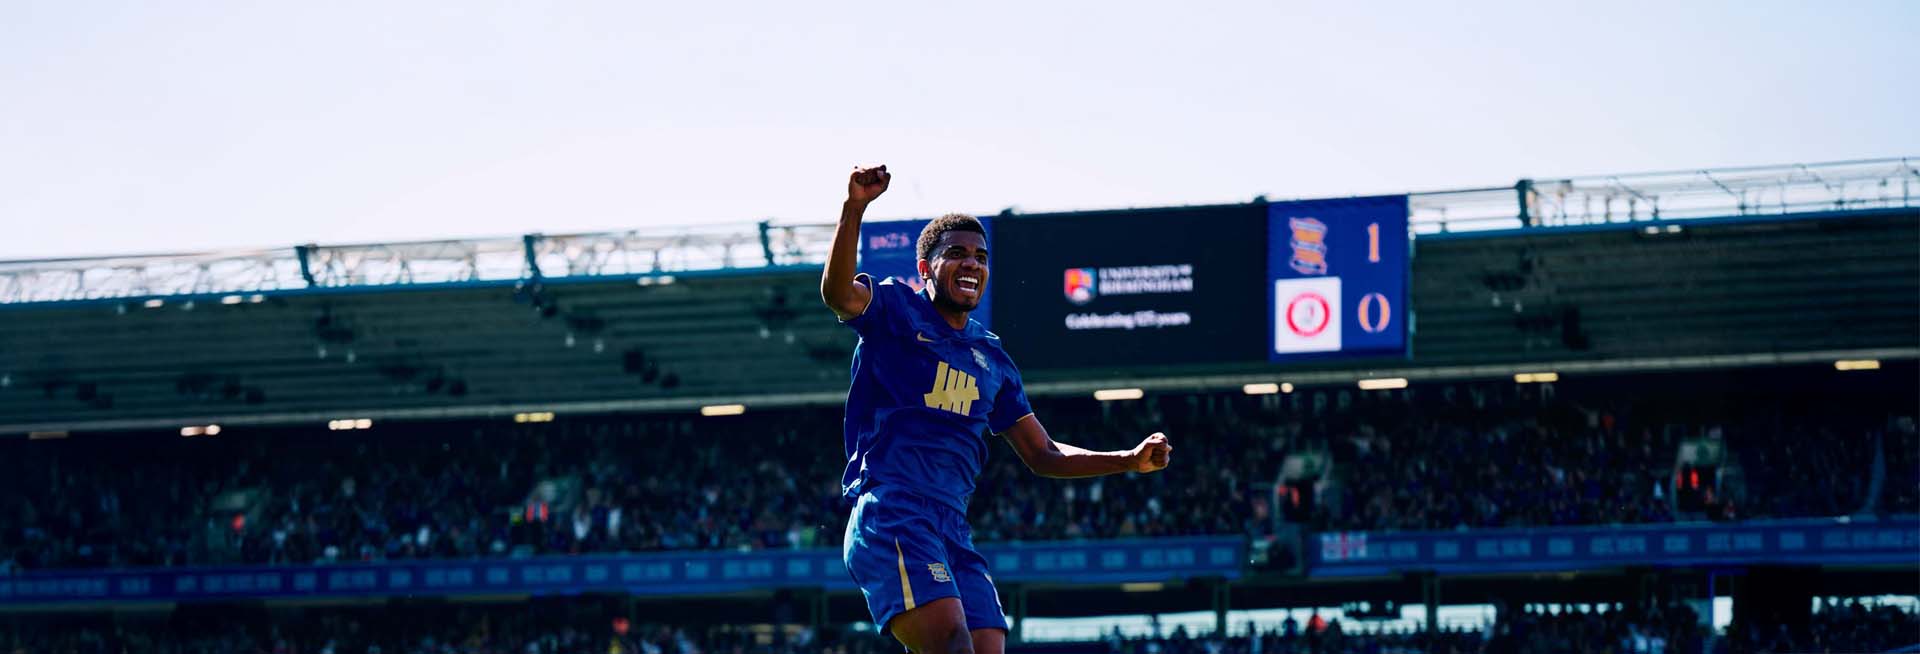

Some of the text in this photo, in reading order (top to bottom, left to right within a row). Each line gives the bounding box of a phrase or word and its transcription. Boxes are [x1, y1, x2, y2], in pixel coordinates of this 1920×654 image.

[1367, 222, 1380, 263] 1
[1099, 278, 1193, 294] BIRMINGHAM
[1065, 312, 1134, 329] Celebrating
[1358, 292, 1391, 332] 0
